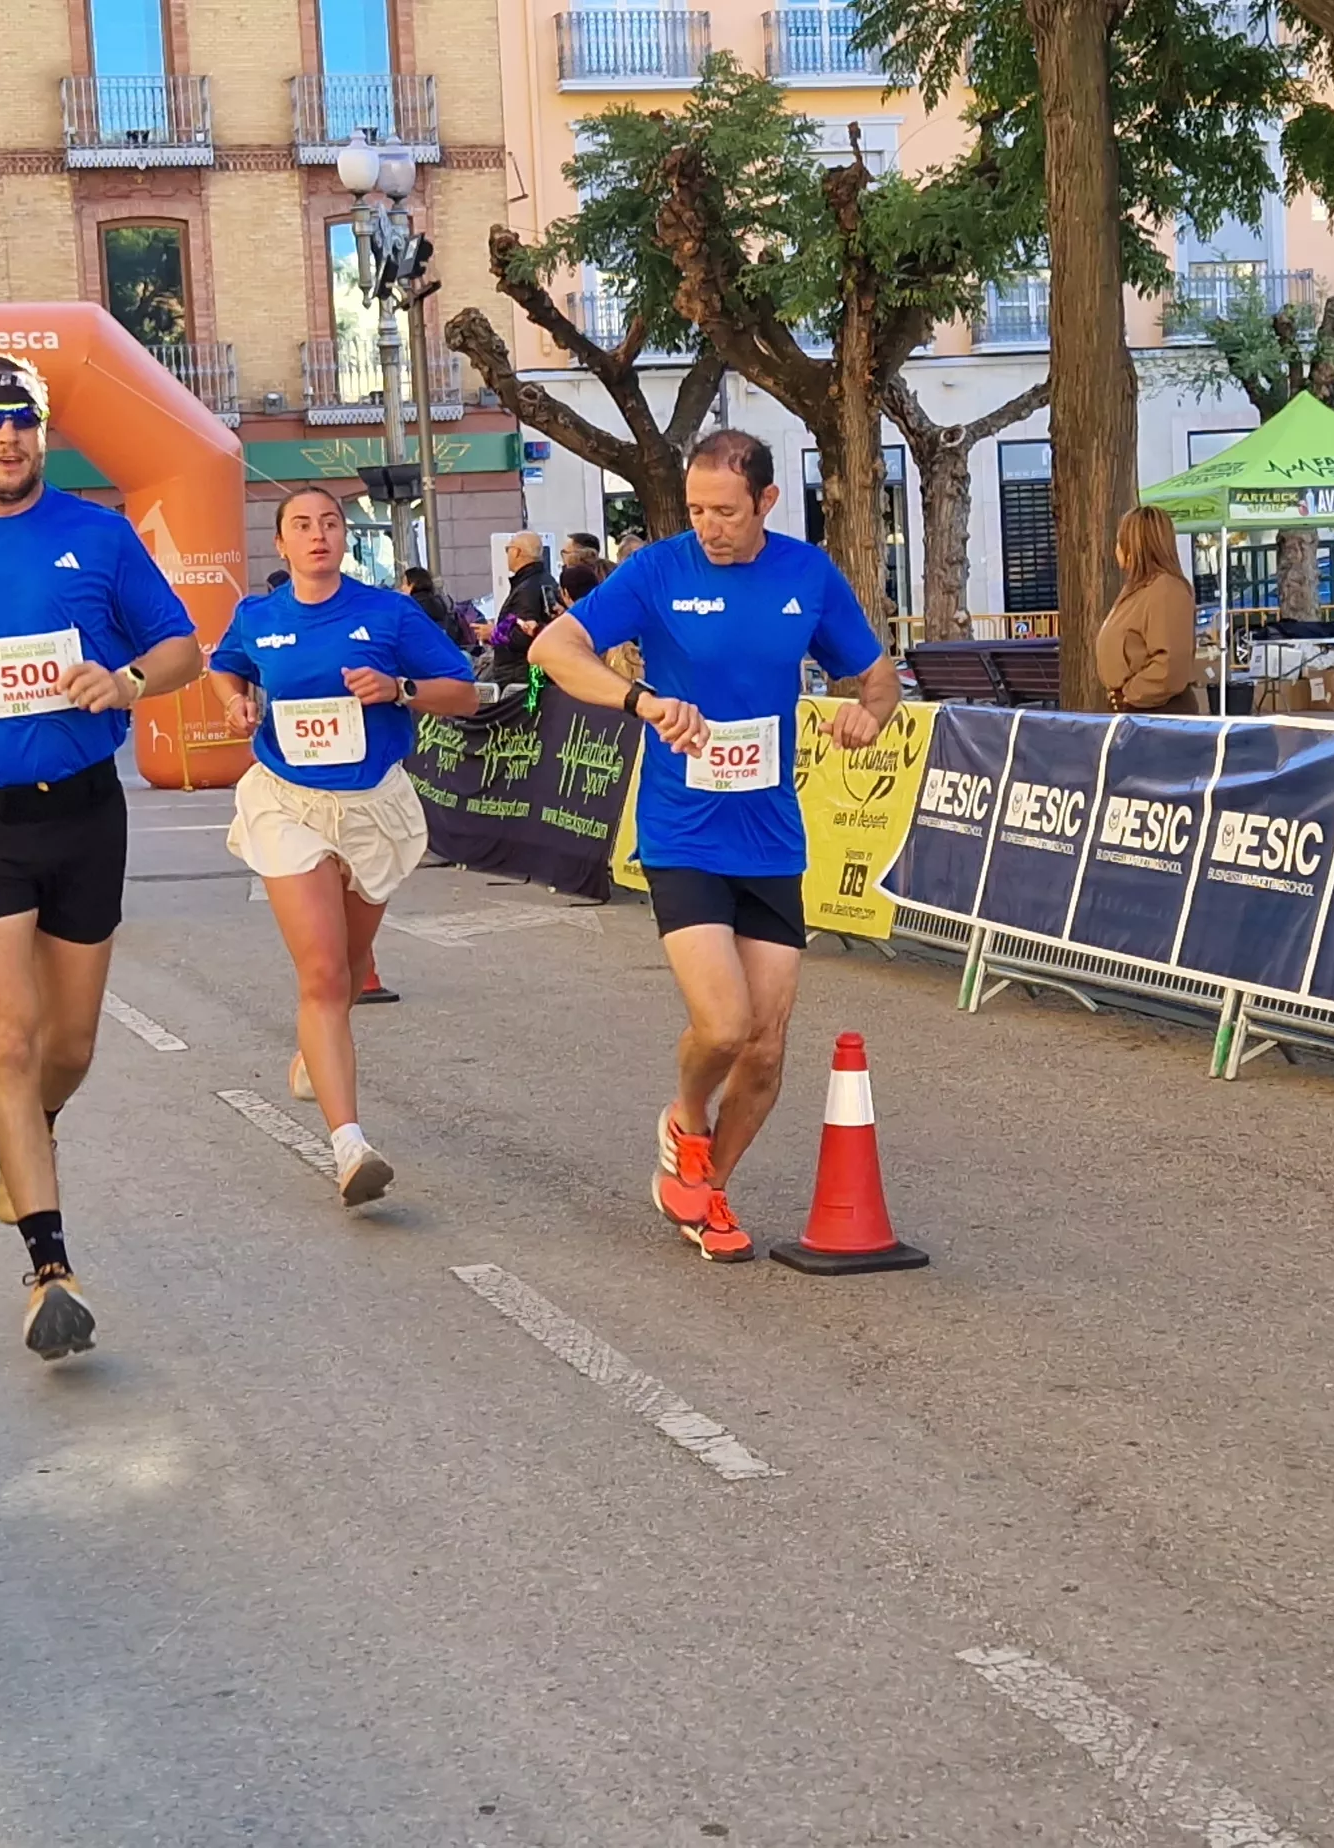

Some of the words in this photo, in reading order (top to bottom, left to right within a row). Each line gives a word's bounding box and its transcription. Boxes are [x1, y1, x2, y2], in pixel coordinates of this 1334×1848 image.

[152, 548, 242, 569] untamiento
[0, 661, 60, 688] 500
[3, 688, 63, 702] MANUEL
[12, 703, 31, 714] 8K
[295, 717, 340, 738] 501
[309, 740, 332, 749] ANA
[709, 744, 761, 767] 502
[938, 771, 992, 821] ESIC
[1024, 784, 1085, 837] ESIC
[1122, 799, 1193, 855] ESIC
[1237, 813, 1324, 876] ESIC
